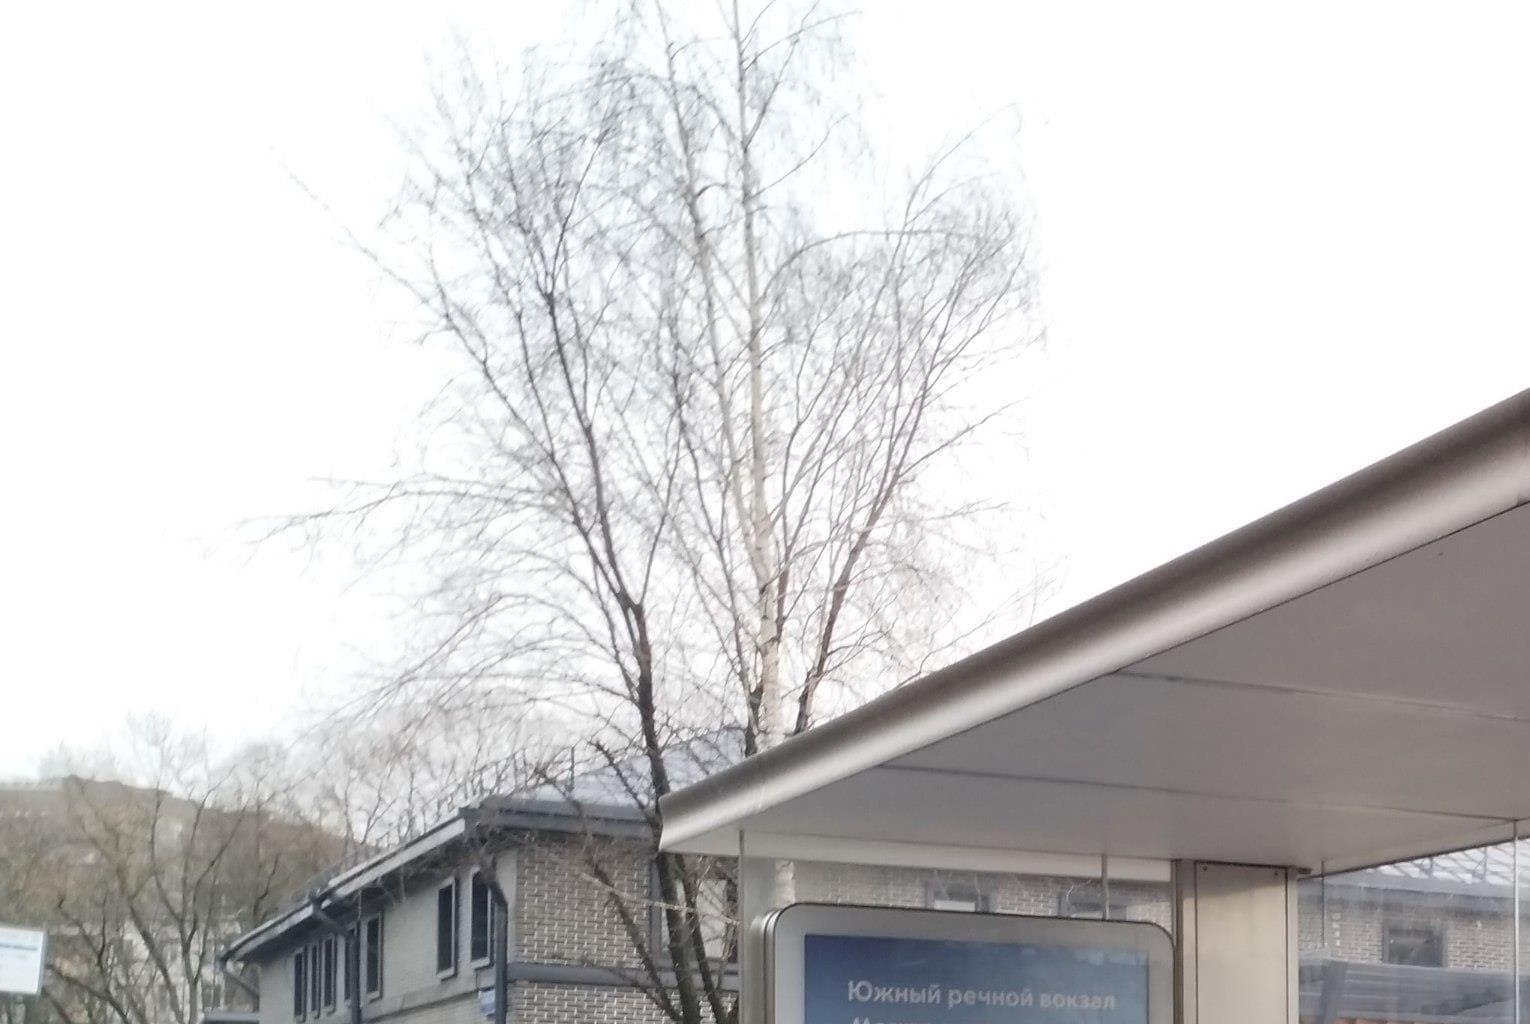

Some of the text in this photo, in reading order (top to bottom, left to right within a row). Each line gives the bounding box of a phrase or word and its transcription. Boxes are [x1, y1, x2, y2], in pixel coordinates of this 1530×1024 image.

[847, 979, 1118, 1011] Южный речной вокзал
